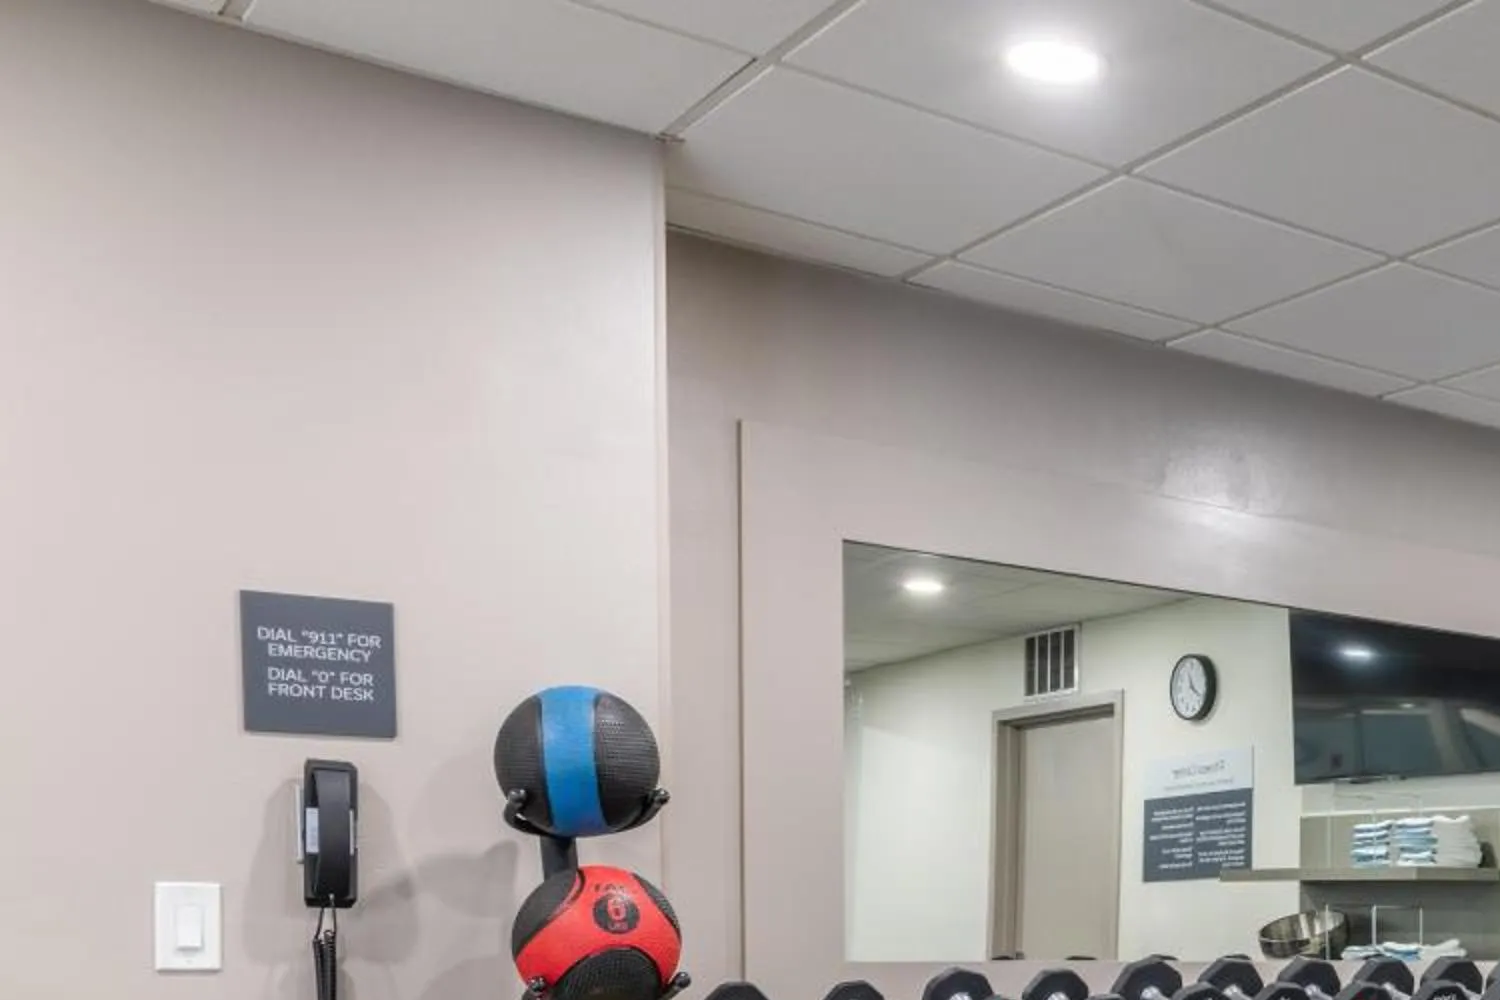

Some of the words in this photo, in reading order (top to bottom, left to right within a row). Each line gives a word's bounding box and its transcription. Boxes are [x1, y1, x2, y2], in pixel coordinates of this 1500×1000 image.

[257, 627, 296, 642] DIAL
[347, 633, 382, 649] FOR
[268, 644, 371, 662] EMERGENCY
[268, 667, 306, 682] DIAL
[340, 672, 374, 686] FOR
[268, 682, 327, 699] FRONT
[330, 686, 374, 701] DESK
